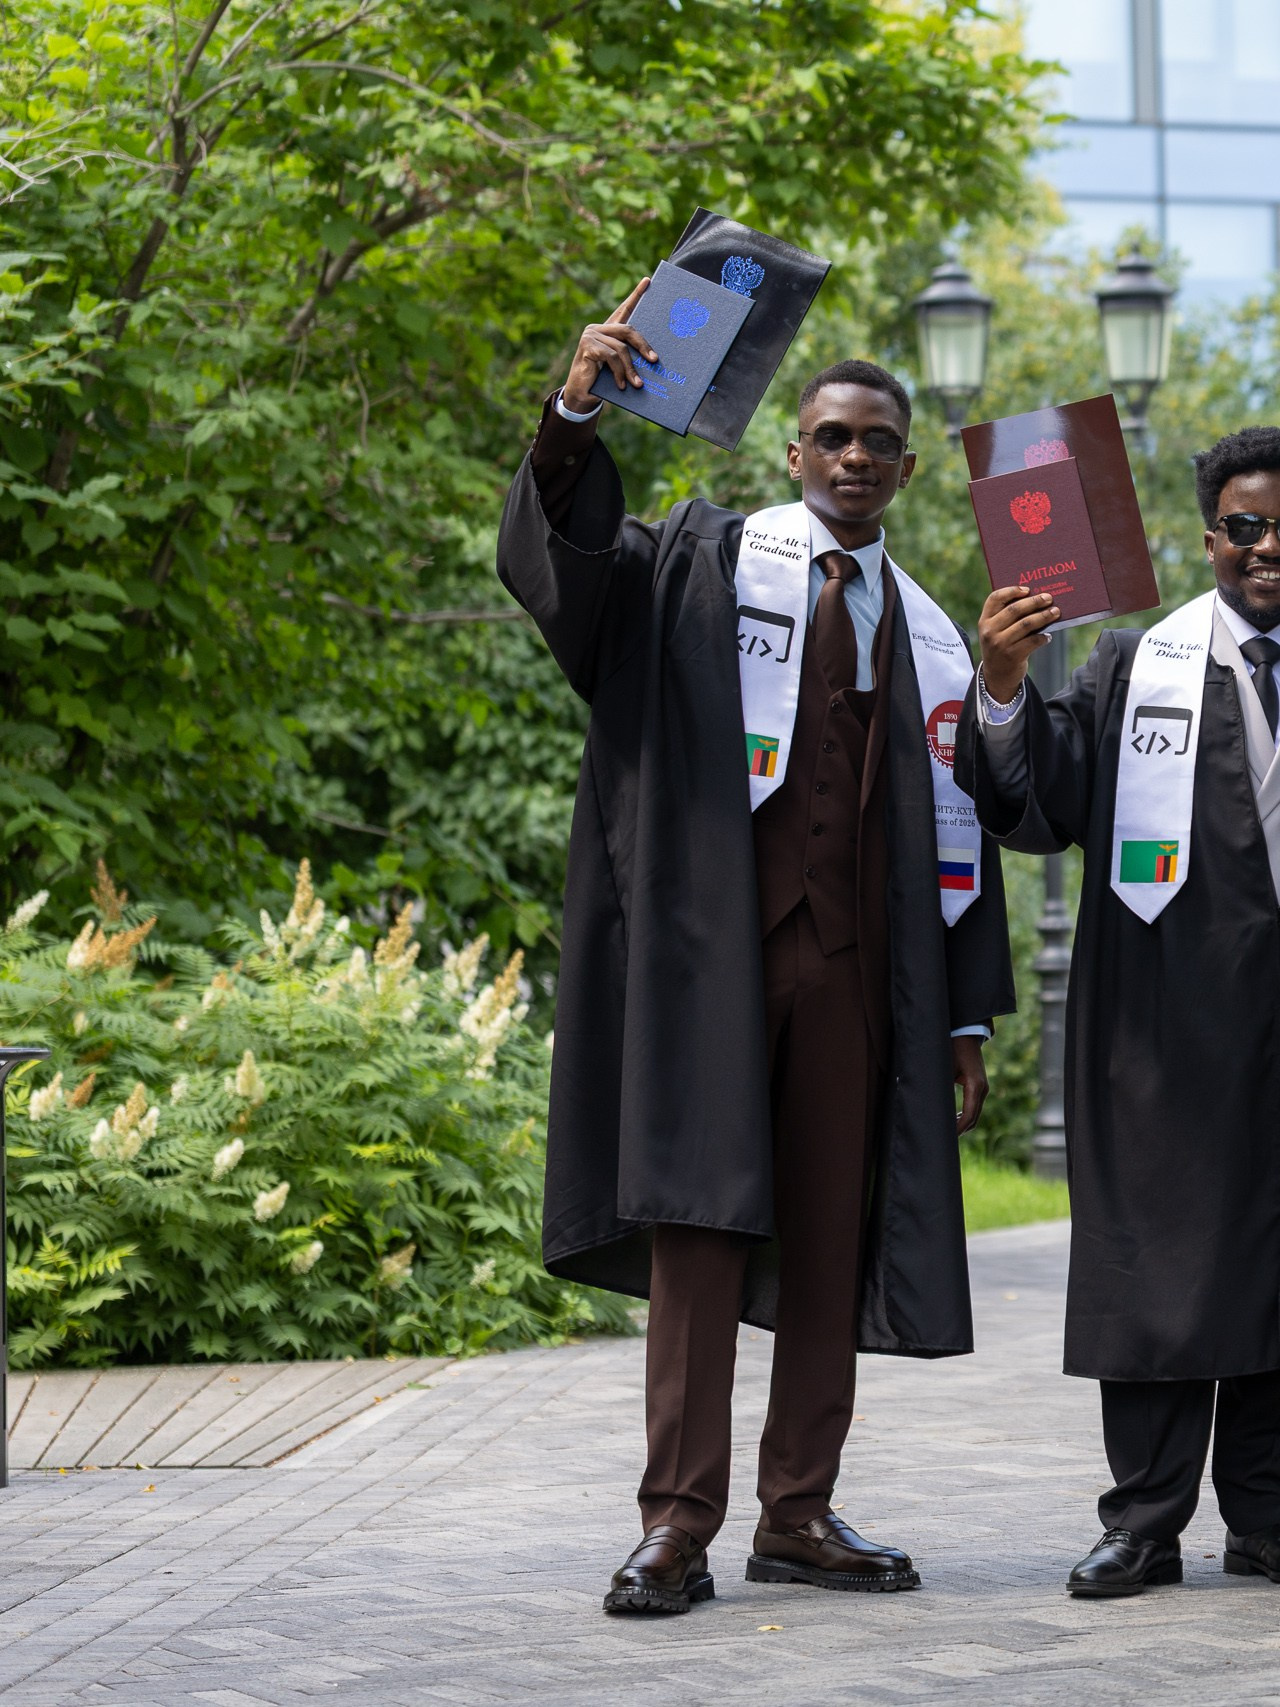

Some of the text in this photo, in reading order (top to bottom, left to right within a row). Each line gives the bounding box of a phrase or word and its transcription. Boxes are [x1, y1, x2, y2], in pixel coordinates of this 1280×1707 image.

[633, 357, 687, 386] ДИПЛОМ
[745, 529, 768, 541] Ctrl
[781, 537, 799, 547] Alt
[749, 541, 802, 560] Graduate
[1019, 560, 1077, 585] ДИПЛОМ
[911, 633, 928, 642] Eng.
[1155, 649, 1190, 660] Didici
[938, 748, 955, 757] КНИ
[950, 818, 959, 827] of
[959, 819, 976, 827] 2026
